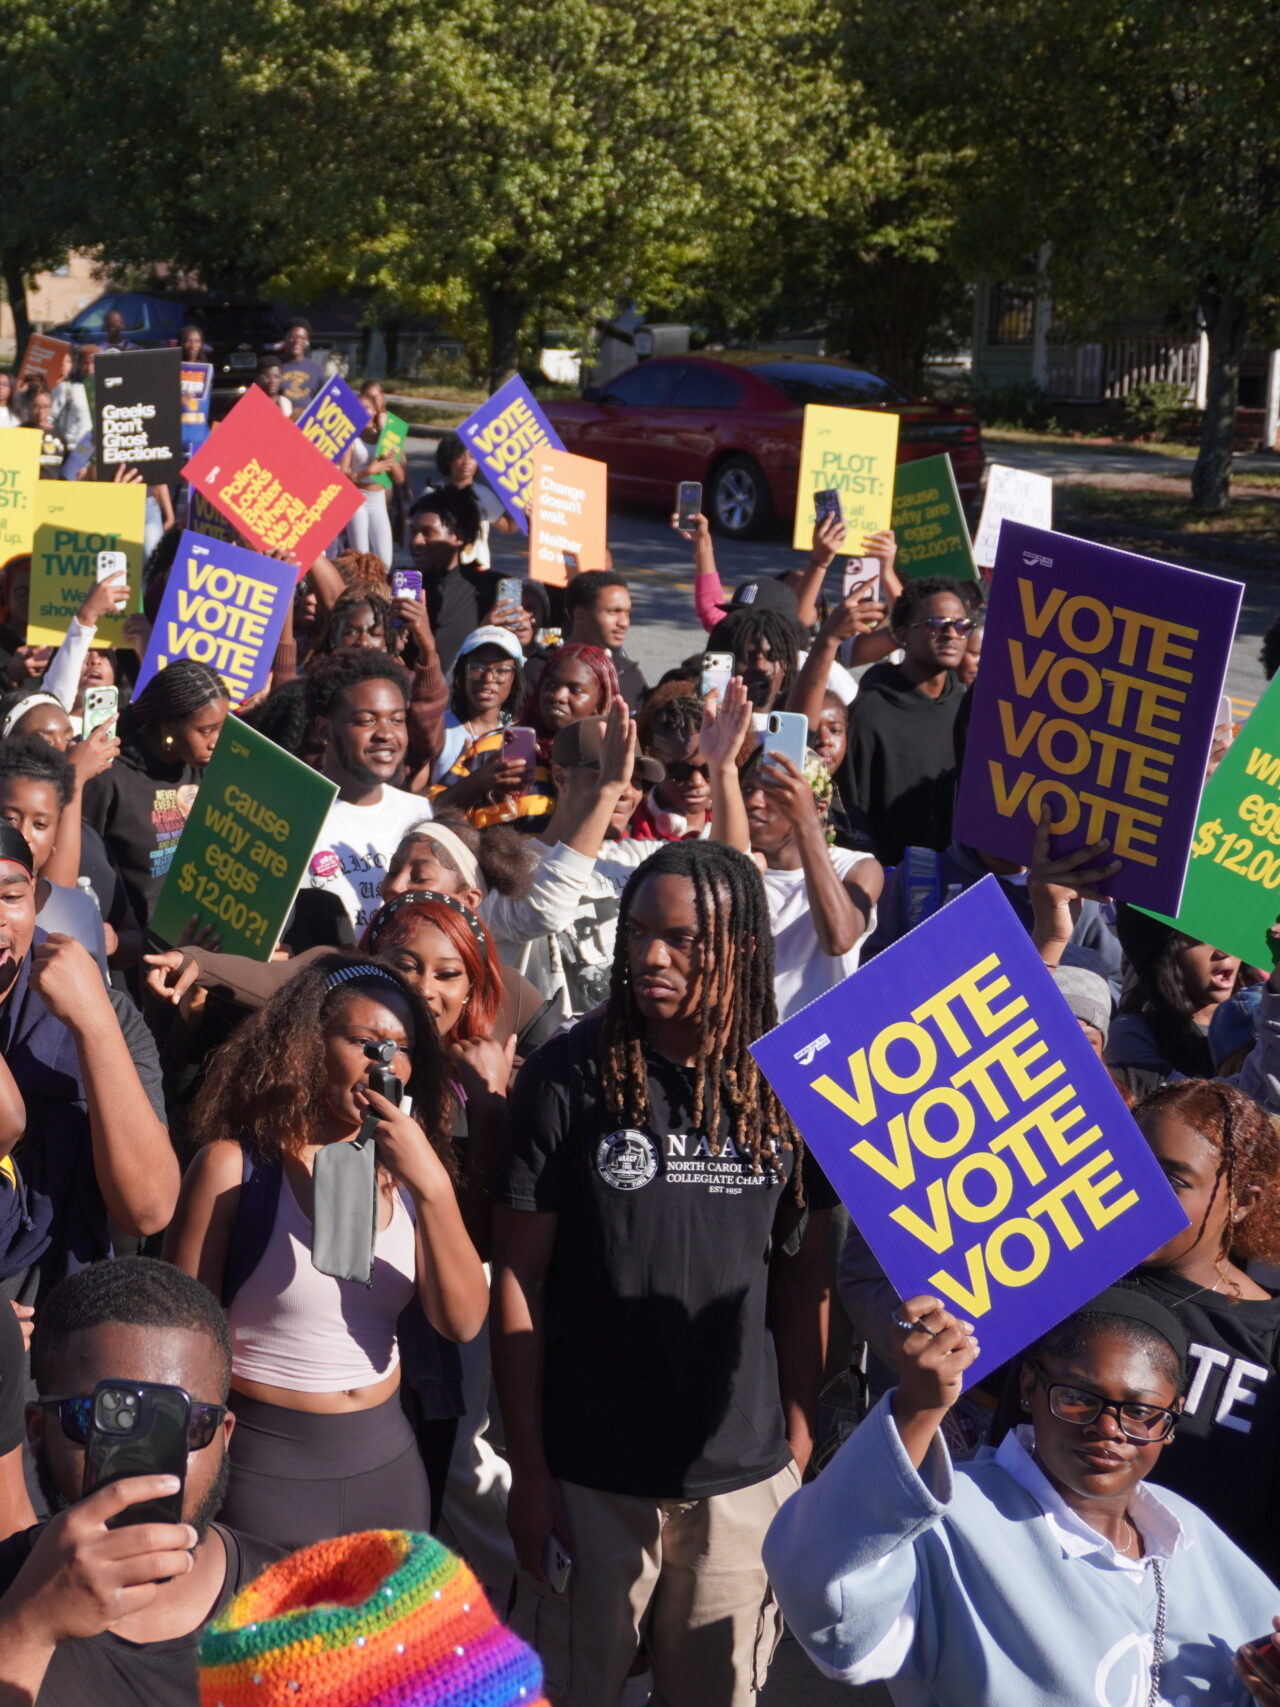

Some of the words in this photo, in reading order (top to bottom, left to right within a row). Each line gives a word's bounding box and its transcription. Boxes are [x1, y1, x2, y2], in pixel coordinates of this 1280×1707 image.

[102, 403, 156, 420] Greeks
[103, 417, 144, 435] Don't
[316, 395, 357, 448] VOTE
[472, 396, 533, 454] VOTE
[103, 432, 148, 449] Ghost
[103, 446, 173, 464] Elections.
[484, 416, 545, 474] VOTE
[821, 450, 878, 474] PLOT
[219, 457, 261, 505] Policy
[230, 468, 272, 516] Looks
[241, 479, 283, 526] Better
[540, 476, 586, 501] Change
[810, 470, 884, 497] TWIST:
[893, 487, 940, 509] cause
[251, 491, 294, 536] When
[261, 520, 290, 548] We
[285, 497, 307, 523] All
[892, 508, 921, 528] why
[925, 502, 951, 520] are
[903, 521, 942, 542] eggs
[4, 533, 23, 546] up.
[54, 530, 122, 554] PLOT
[538, 530, 583, 553] Neither
[538, 546, 555, 562] do
[898, 535, 962, 565] $12.00?!
[187, 558, 278, 616] VOTE
[178, 589, 269, 647] VOTE
[1018, 577, 1199, 684] VOTE
[167, 621, 259, 680] VOTE
[1007, 638, 1187, 746] VOTE
[997, 699, 1175, 807] VOTE
[224, 784, 291, 842] cause
[988, 760, 1163, 868] VOTE
[204, 803, 252, 854] why
[249, 839, 289, 878] are
[204, 843, 260, 894] eggs
[176, 861, 269, 946] $12.00?!
[809, 952, 1029, 1126] VOTE
[849, 1018, 1066, 1190] VOTE
[666, 1162, 705, 1171] NORTH
[666, 1174, 734, 1185] COLLEGIATE
[888, 1083, 1103, 1254] VOTE
[725, 1187, 742, 1195] 1952
[927, 1149, 1139, 1319] VOTE
[1184, 1342, 1269, 1433] TE
